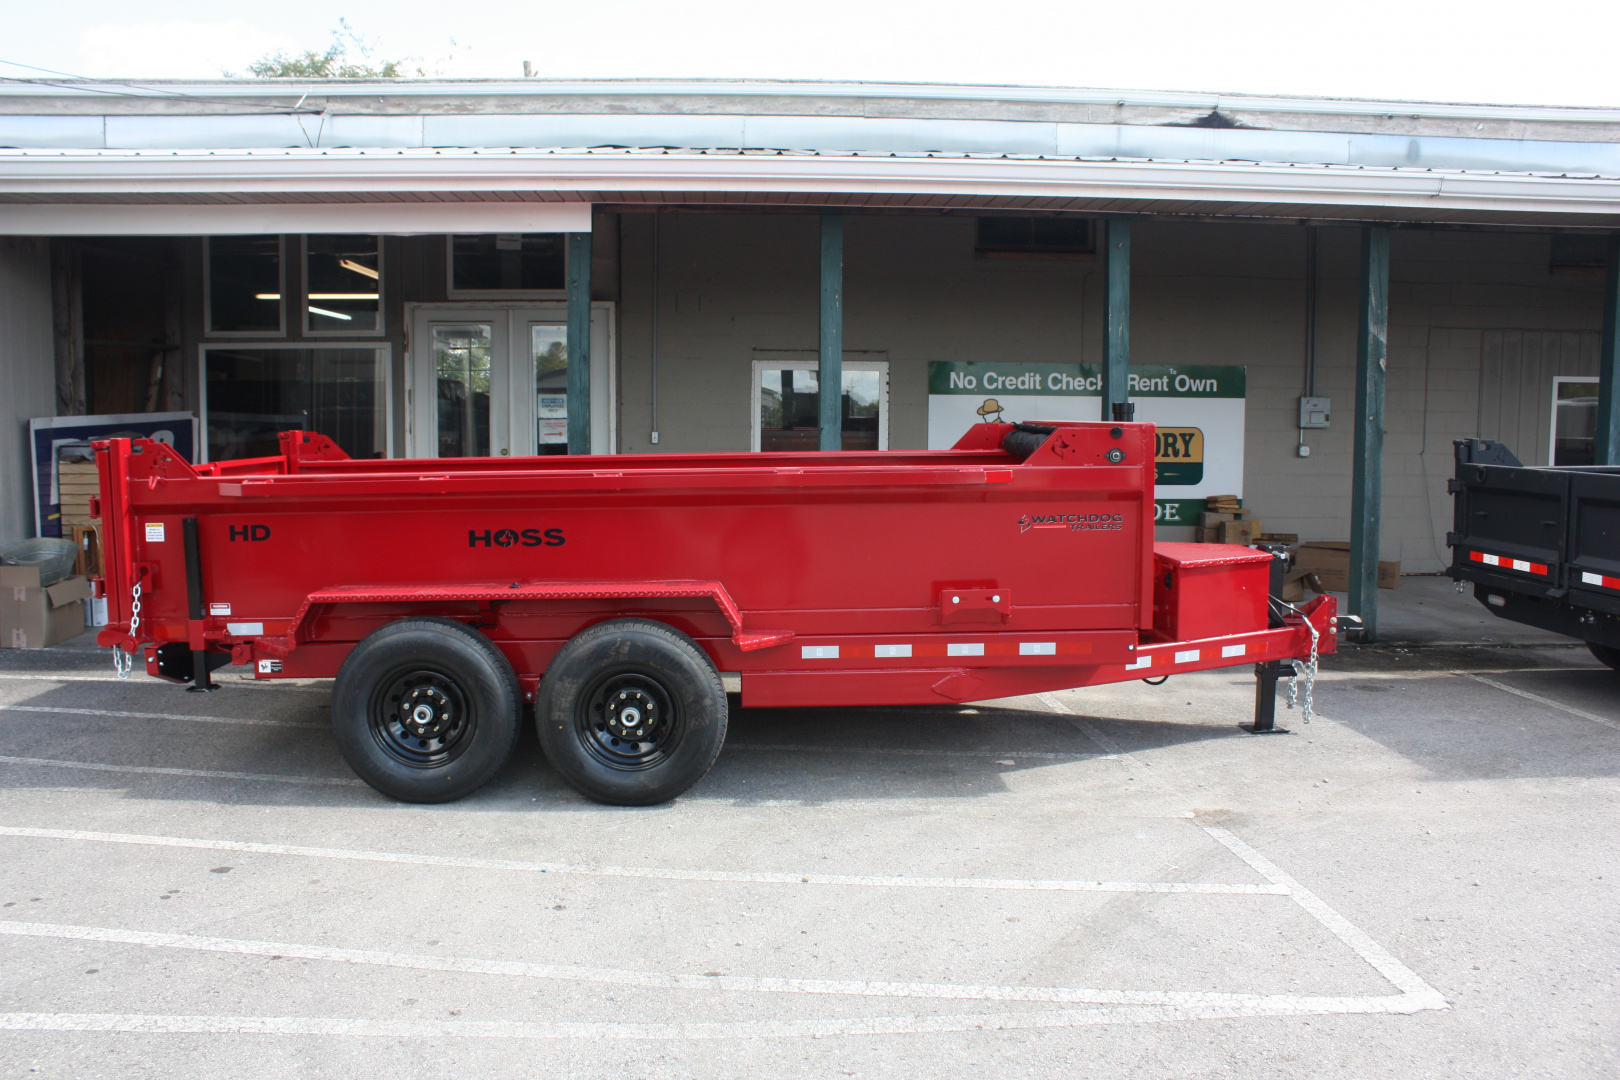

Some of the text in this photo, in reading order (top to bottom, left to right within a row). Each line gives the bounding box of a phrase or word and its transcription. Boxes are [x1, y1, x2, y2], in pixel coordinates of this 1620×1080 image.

[949, 371, 977, 390] No
[983, 372, 1042, 390] Credit
[1128, 374, 1169, 392] Rent
[1174, 374, 1218, 393] Own
[1032, 514, 1123, 524] WATCHDOG
[229, 525, 271, 541] HD
[468, 528, 566, 547] HOSS
